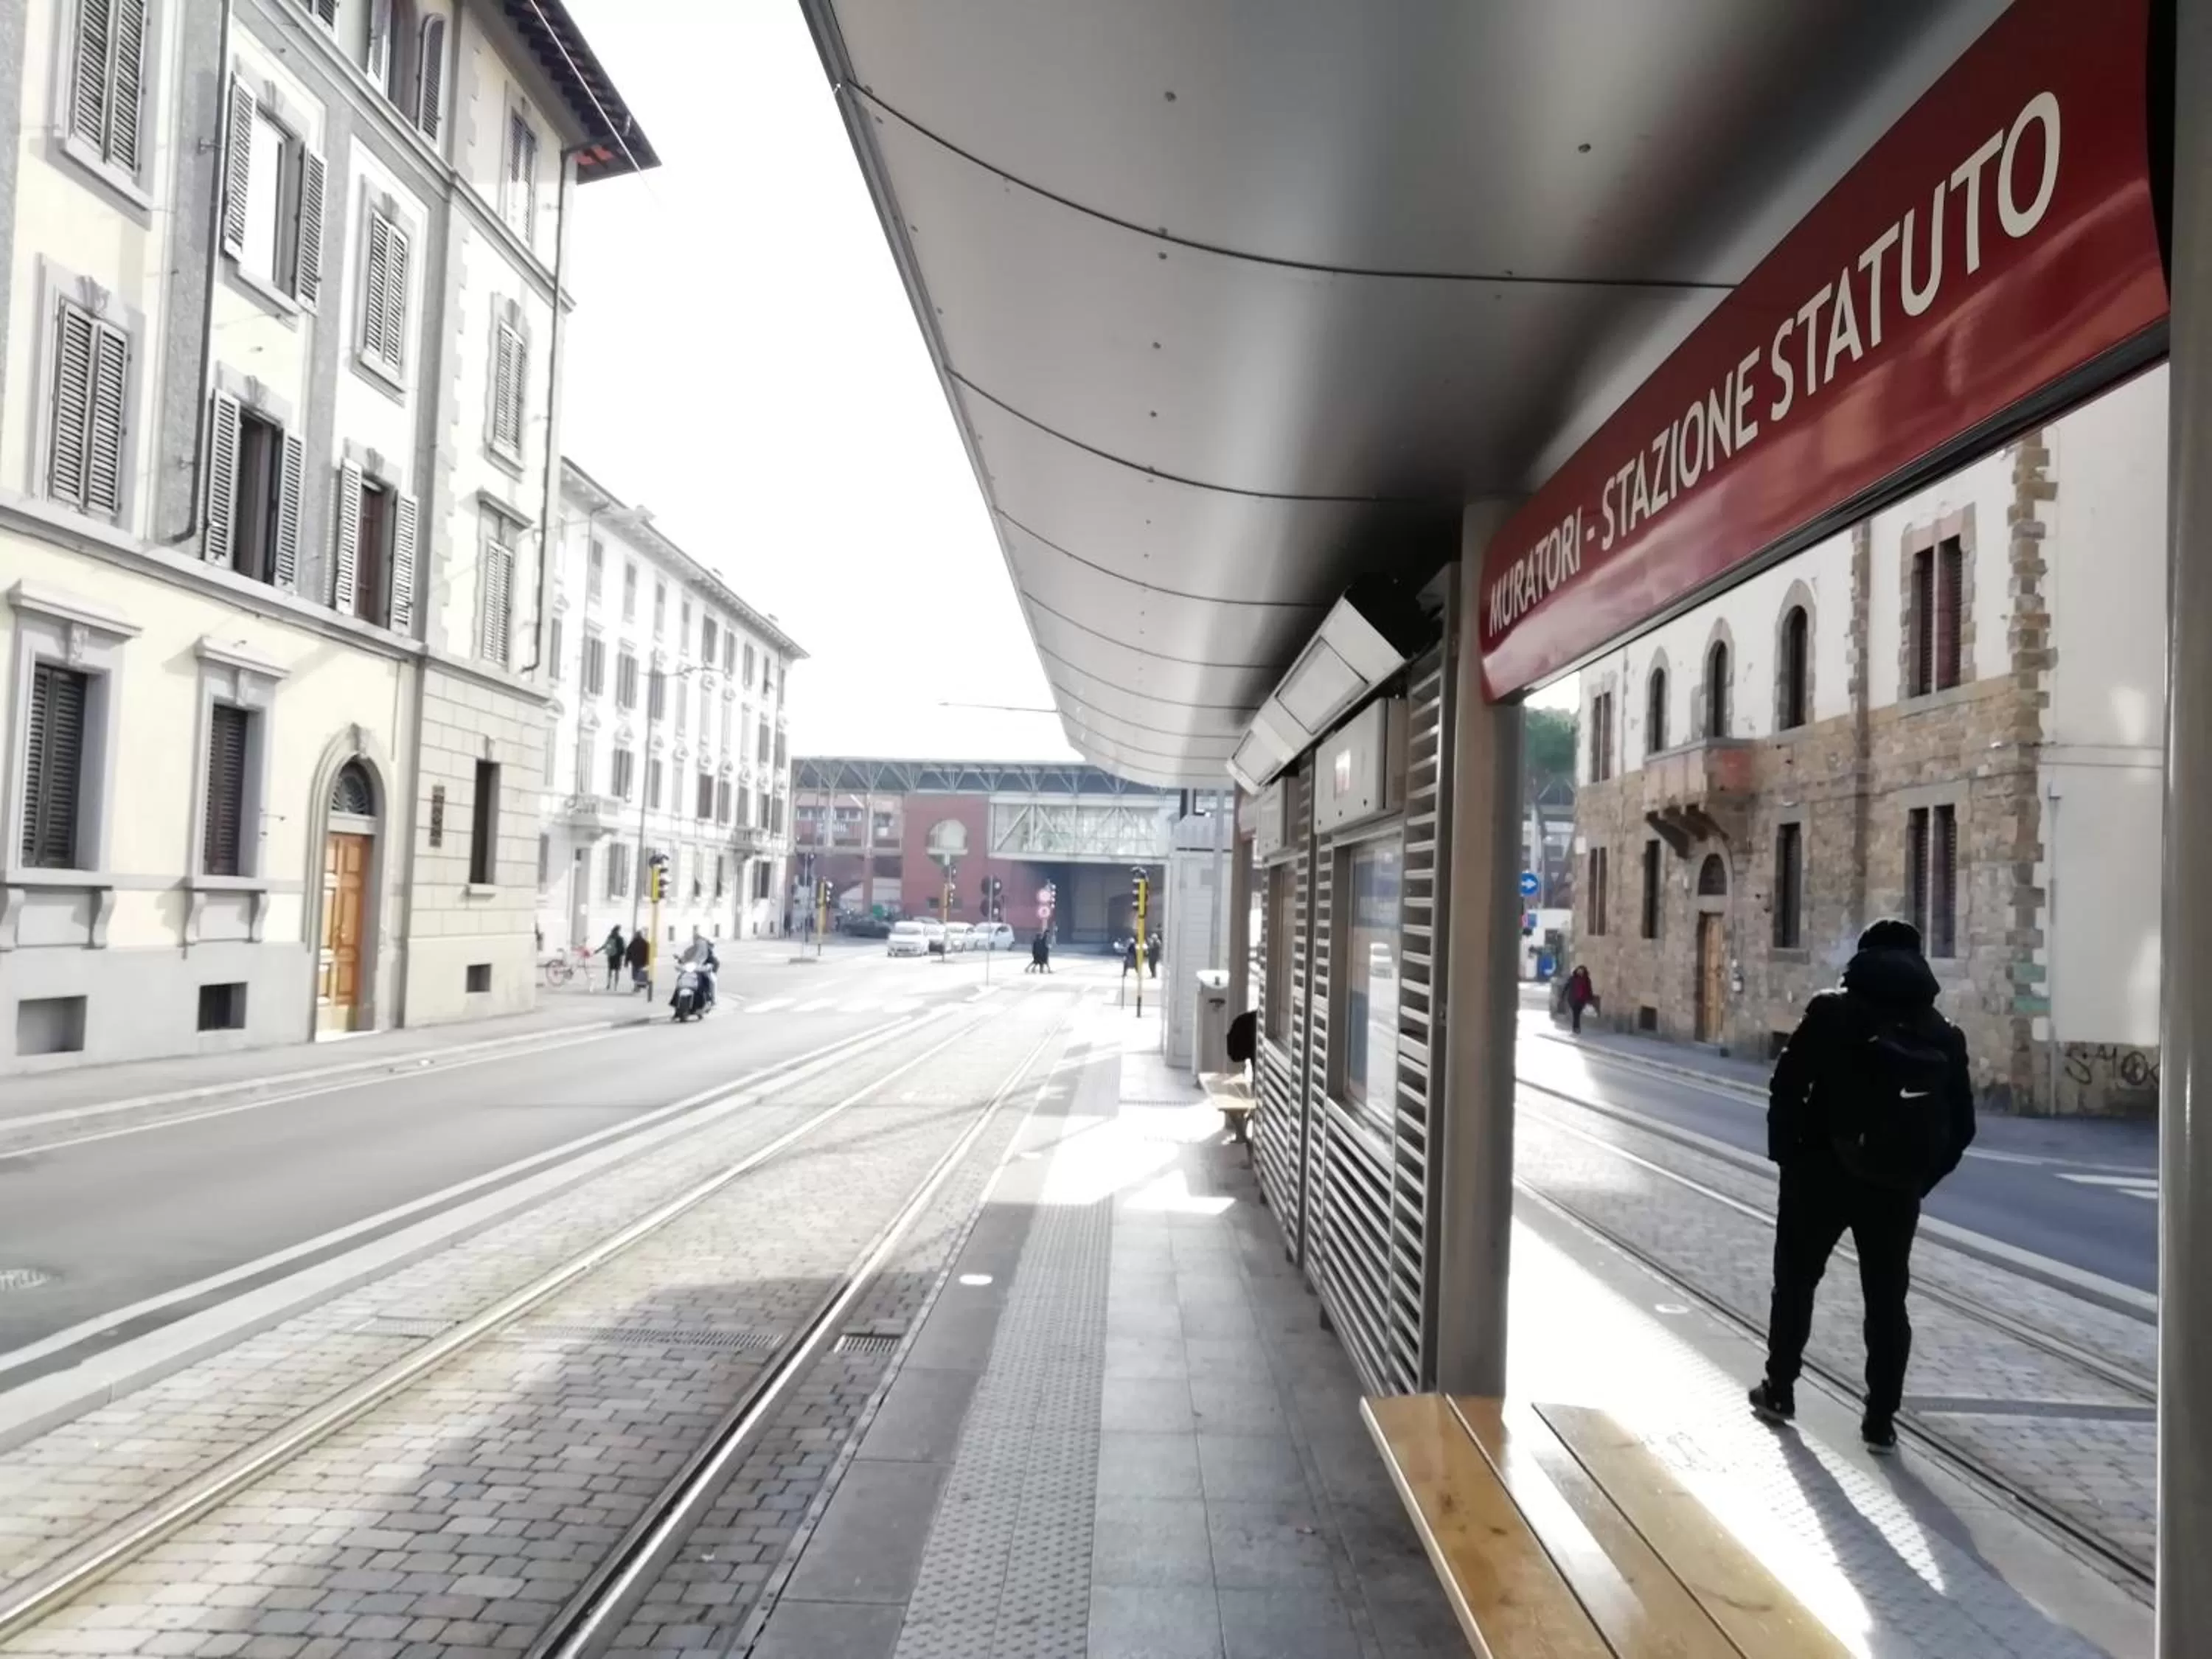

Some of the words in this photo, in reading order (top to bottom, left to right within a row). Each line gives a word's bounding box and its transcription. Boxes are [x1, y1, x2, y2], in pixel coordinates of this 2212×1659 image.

[1489, 505, 1583, 637] MURATORI
[1586, 525, 1595, 541] -
[1601, 346, 1761, 552] STAZIONE
[1770, 91, 2062, 422] STATUTO
